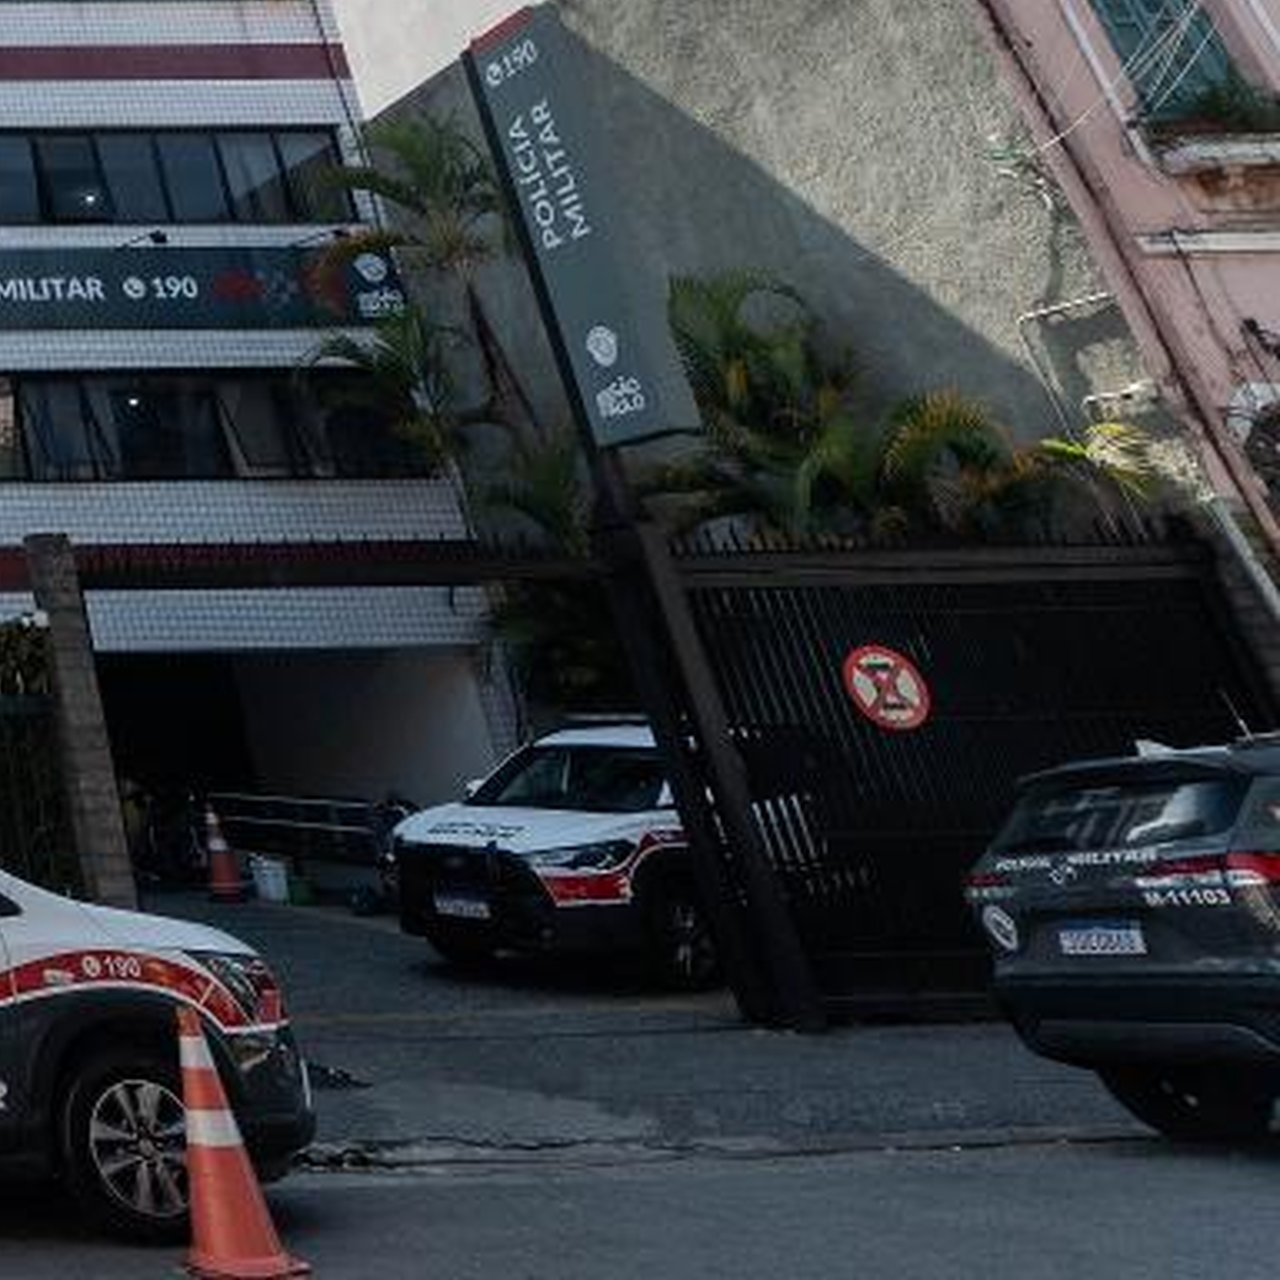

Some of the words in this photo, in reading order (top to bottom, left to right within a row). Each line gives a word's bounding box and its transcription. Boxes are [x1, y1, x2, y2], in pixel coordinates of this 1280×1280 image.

[508, 116, 562, 249] POLÍCIA
[531, 99, 592, 241] MILITAR
[153, 276, 199, 299] 190
[103, 955, 141, 978] 190
